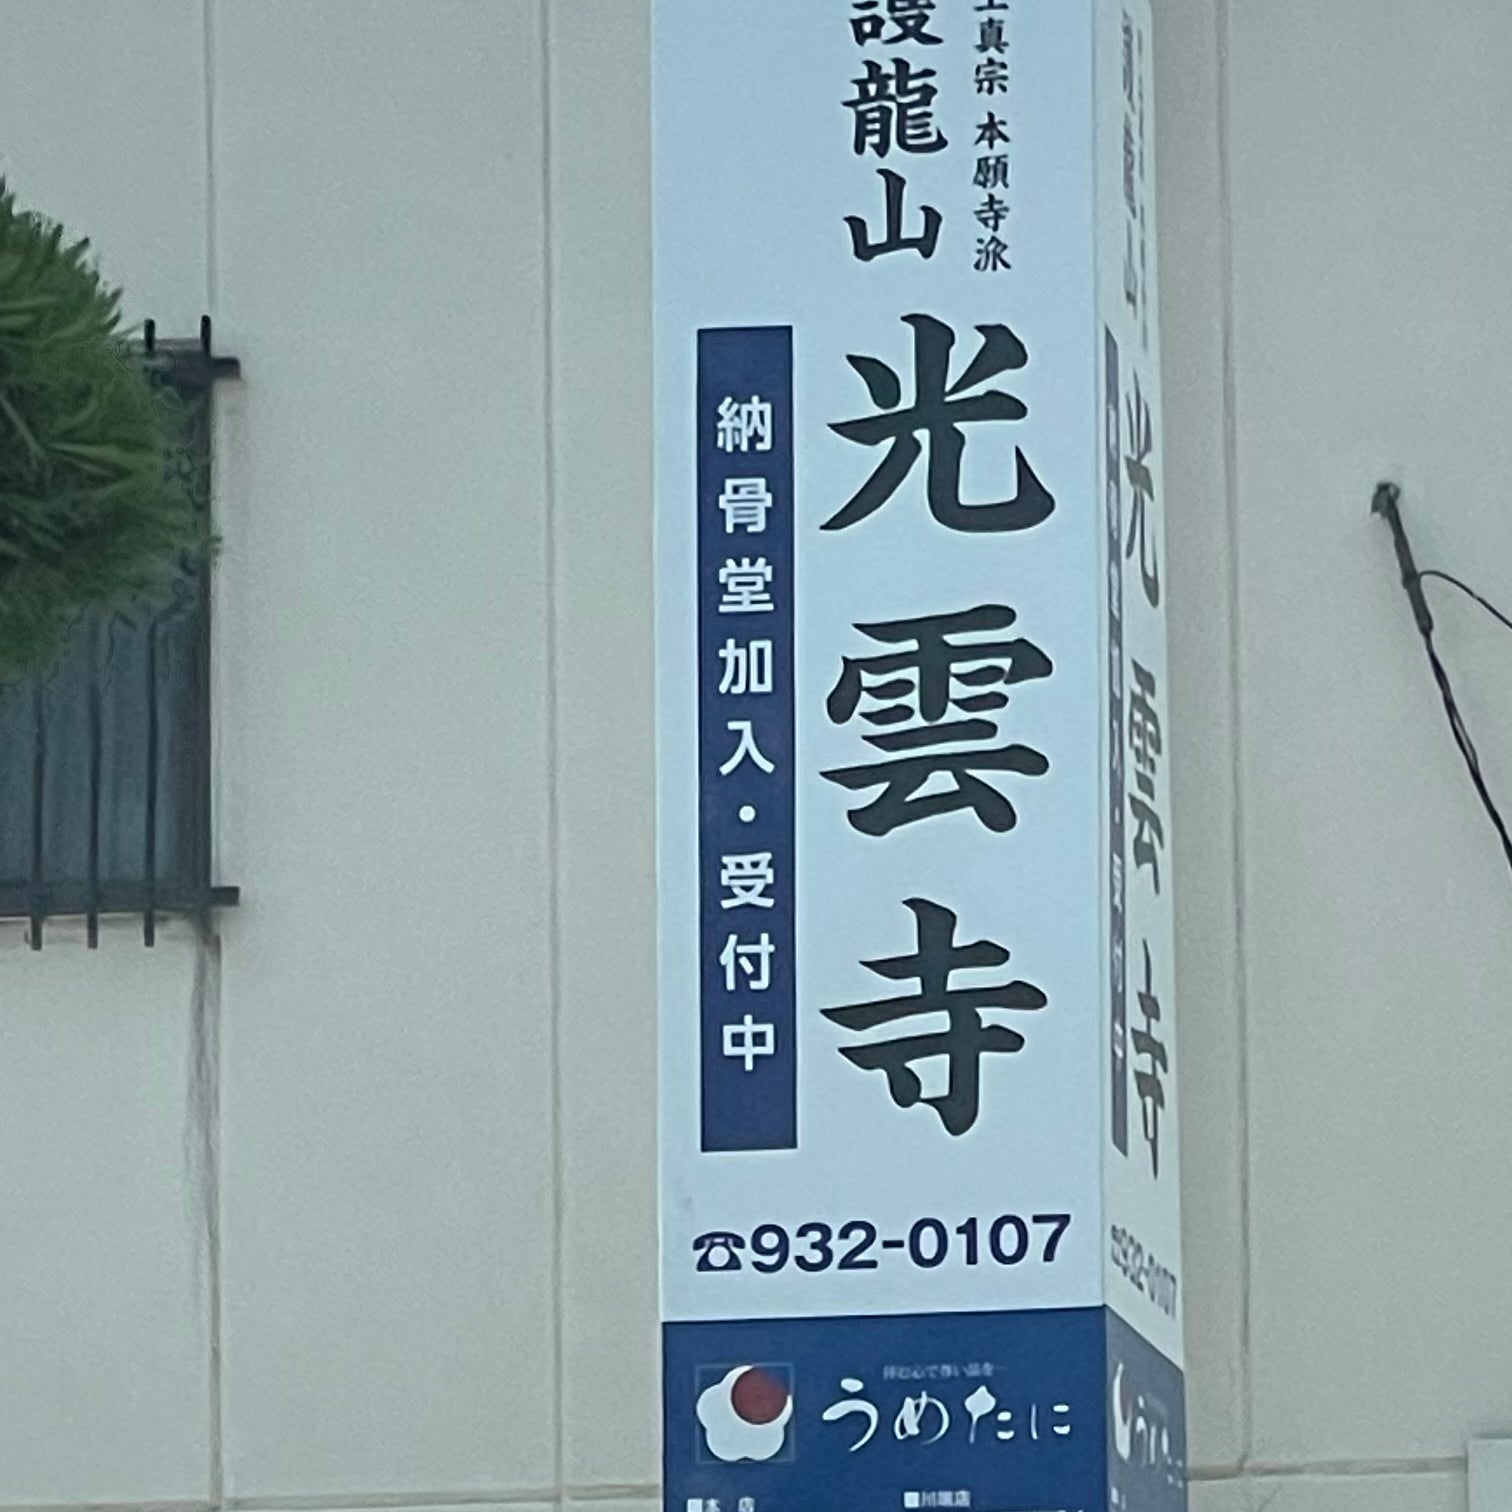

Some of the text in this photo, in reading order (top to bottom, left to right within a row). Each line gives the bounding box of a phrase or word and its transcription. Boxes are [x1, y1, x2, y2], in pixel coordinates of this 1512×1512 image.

[716, 395, 776, 1072] 納骨堂加入・受付中
[818, 312, 1056, 1137] 光雲寺
[822, 1378, 1072, 1452] うめたに
